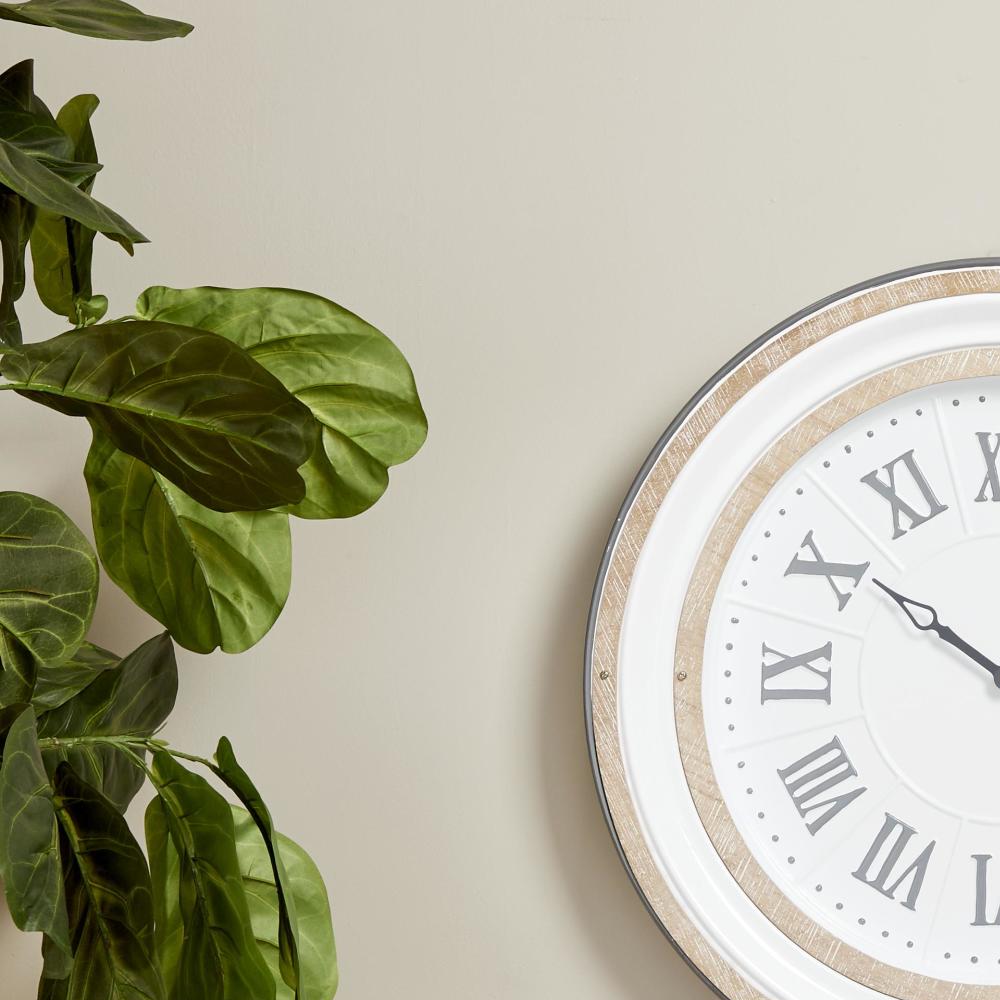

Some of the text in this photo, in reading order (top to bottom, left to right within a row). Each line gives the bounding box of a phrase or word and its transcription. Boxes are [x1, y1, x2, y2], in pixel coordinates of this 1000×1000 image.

[860, 448, 950, 540] XI
[783, 530, 871, 612] X
[760, 640, 833, 706] IX
[775, 734, 868, 836] VIII
[850, 811, 937, 912] VII
